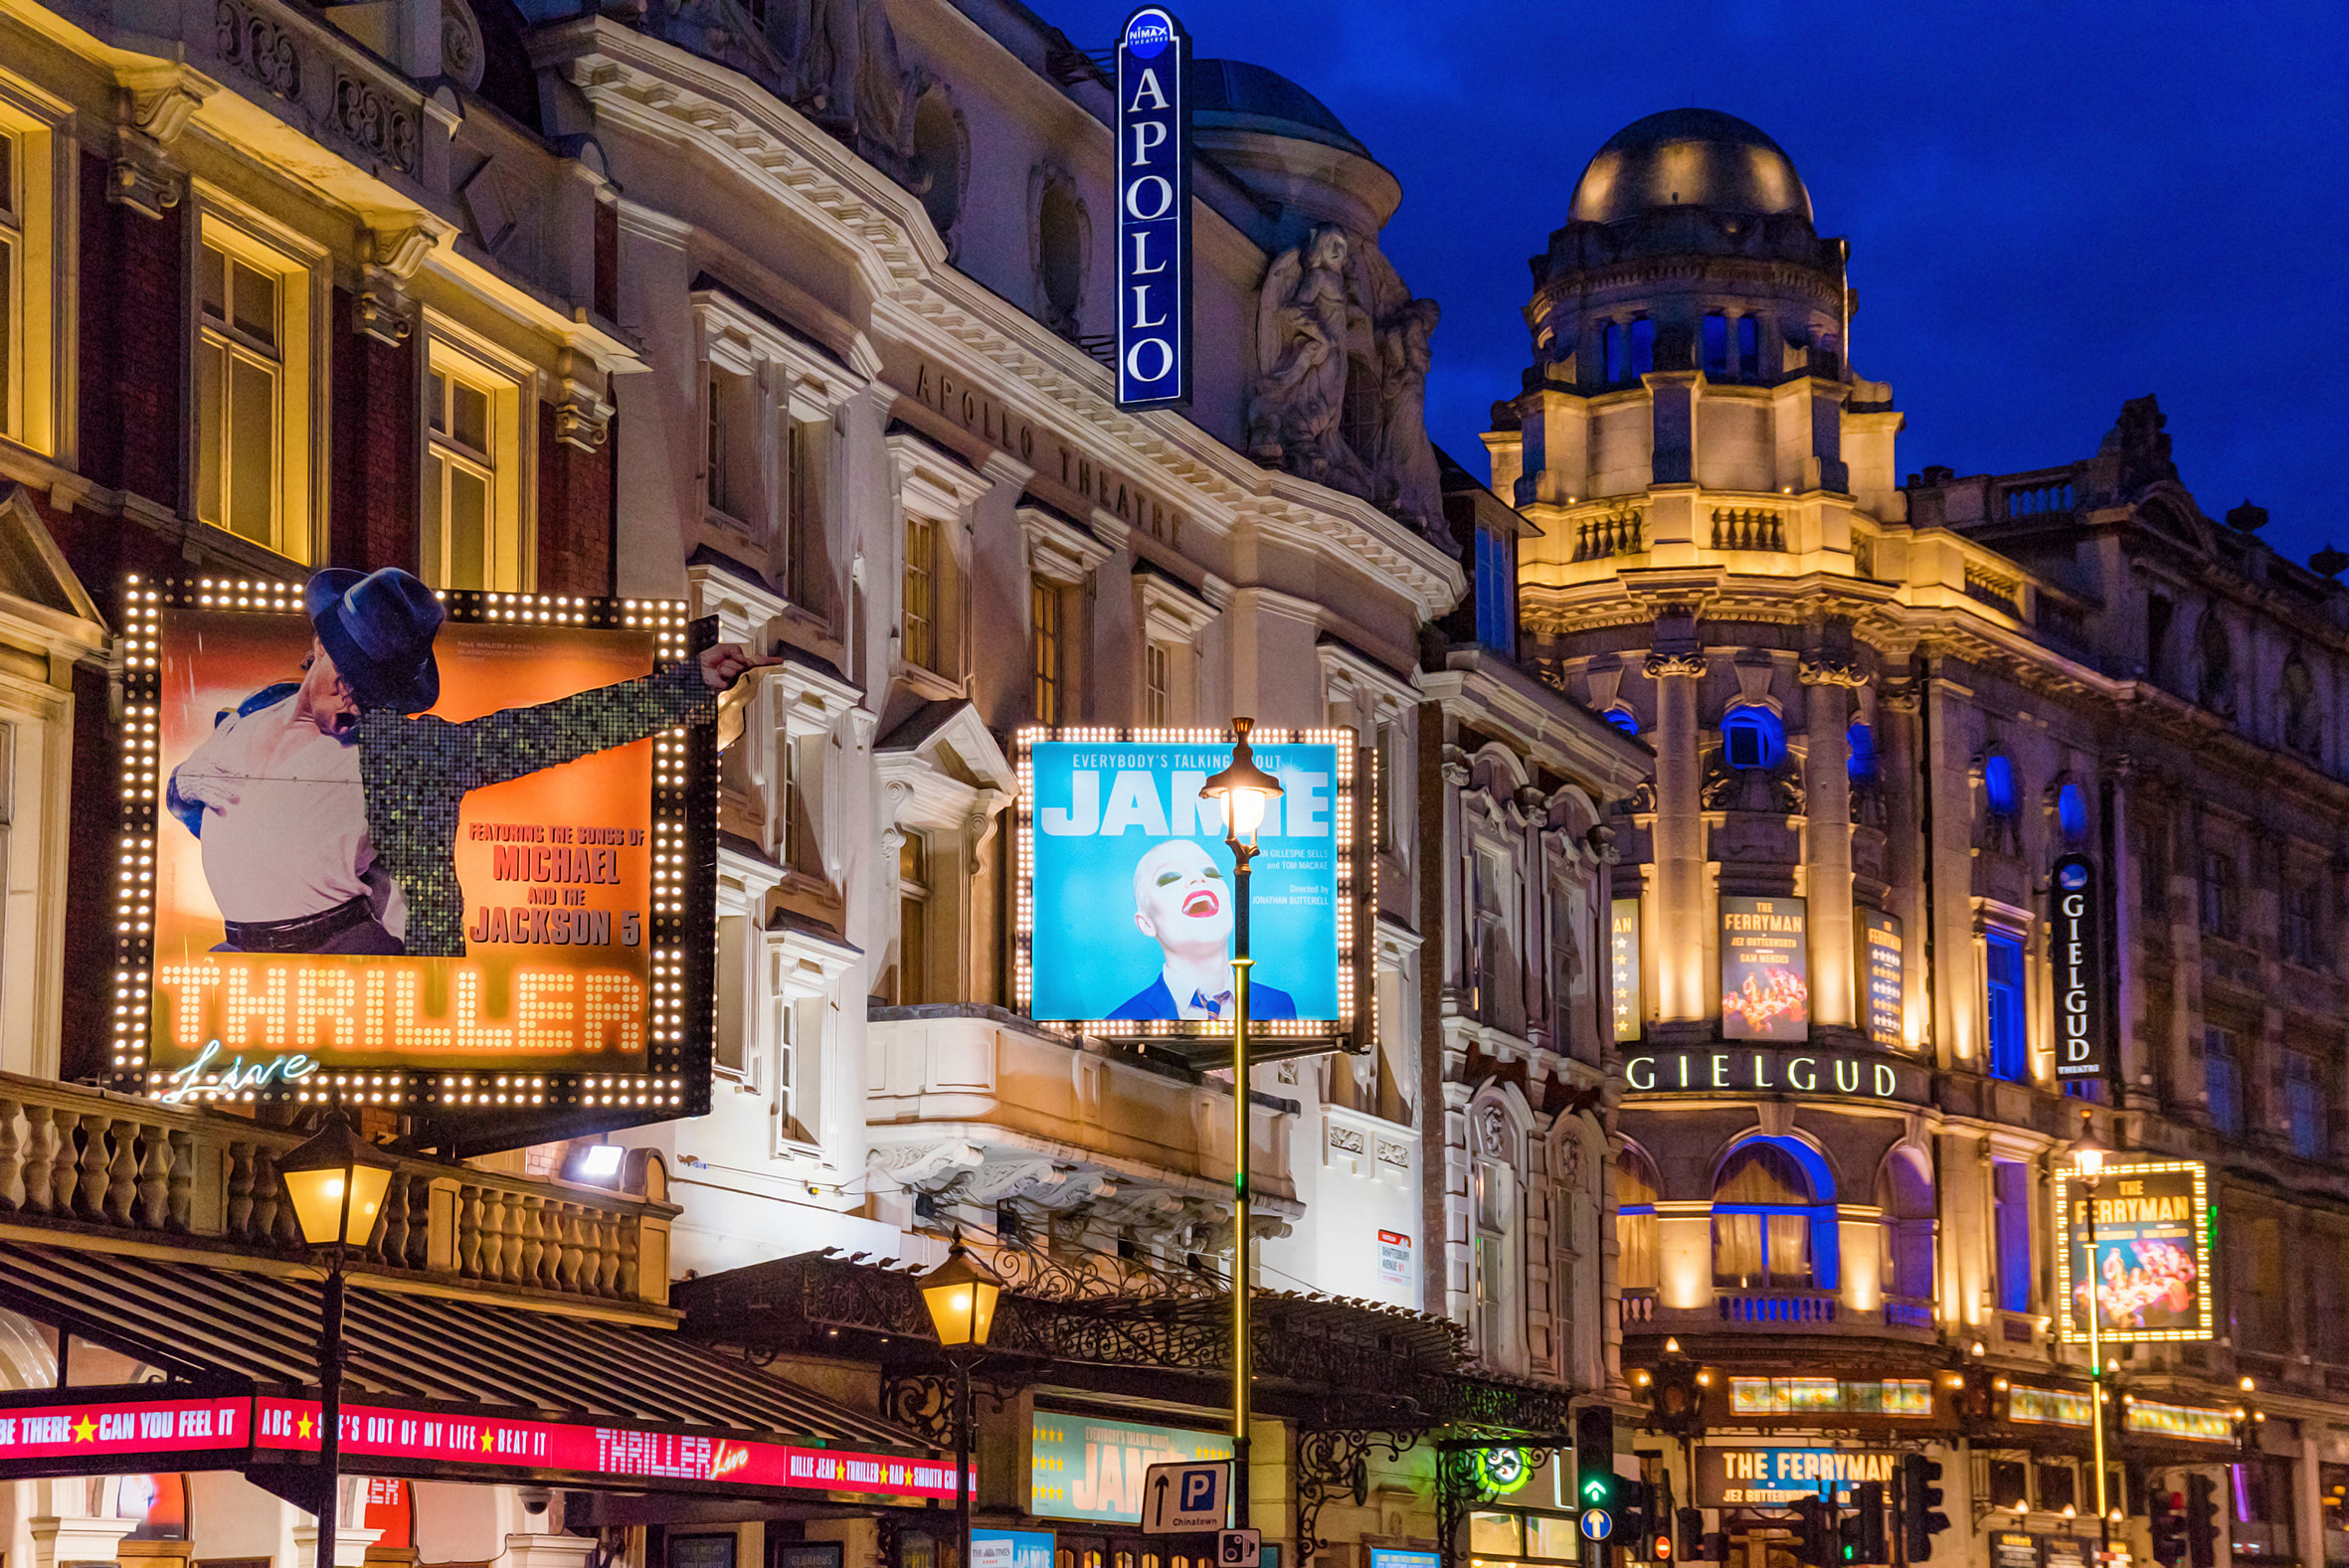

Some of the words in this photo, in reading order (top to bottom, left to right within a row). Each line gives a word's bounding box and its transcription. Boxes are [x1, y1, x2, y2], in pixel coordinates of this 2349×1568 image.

[1127, 68, 1174, 382] APOLLO
[916, 364, 1033, 459] APOLLO
[1060, 447, 1182, 548] THEATRE
[1073, 754, 1168, 769] EVERYBODY'S
[1174, 755, 1231, 769] TALKING
[469, 822, 544, 843] FEATURING
[548, 825, 573, 844] THE
[577, 826, 625, 845] SONGS
[628, 828, 644, 846] OF
[493, 845, 621, 885] MICHAEL
[1270, 849, 1305, 858] GILLESPIE
[1299, 861, 1328, 870] MACRAE
[527, 887, 557, 905] AND
[561, 888, 586, 906] THE
[1252, 896, 1288, 905] JONATHAN
[1290, 896, 1329, 905] BUTTERELL
[1321, 886, 1329, 895] by
[1756, 902, 1773, 913] THE
[469, 906, 612, 946] JACKSON
[621, 910, 640, 946] 5
[1724, 914, 1802, 933] FERRYMAN
[1759, 954, 1789, 964] MENDES
[2063, 894, 2090, 1062] GIELGUD
[161, 964, 640, 1051] THRILLER
[162, 1038, 316, 1104] Live
[1626, 1055, 1897, 1097] GIELGUD
[2118, 1180, 2143, 1196] THE
[22, 1416, 72, 1444] THERE
[99, 1413, 135, 1441] CAN
[140, 1411, 174, 1439] YOU
[178, 1410, 213, 1438] FEEL
[218, 1409, 236, 1436] IT
[262, 1408, 292, 1437] ABC
[317, 1413, 360, 1442] SE'S
[367, 1417, 394, 1444] OUT
[401, 1419, 417, 1446] OF
[424, 1422, 443, 1448] MY
[449, 1424, 476, 1450] LIFE
[497, 1428, 528, 1455] BEAT
[534, 1431, 546, 1456] IT
[1127, 1431, 1151, 1447] TALKING
[596, 1428, 711, 1480] THRILLER
[710, 1439, 748, 1480] Live
[1722, 1452, 1768, 1480] THE
[1777, 1452, 1895, 1481] FERRYMAN
[791, 1455, 813, 1478] BILLIE
[816, 1458, 835, 1480] JEAN
[846, 1460, 879, 1482] THRILLER
[889, 1464, 904, 1485] BAD
[914, 1467, 942, 1488] SMOOTH
[1187, 1475, 1209, 1507] P
[1722, 1488, 1743, 1502] JEZ
[1173, 1517, 1217, 1526] Chinatown
